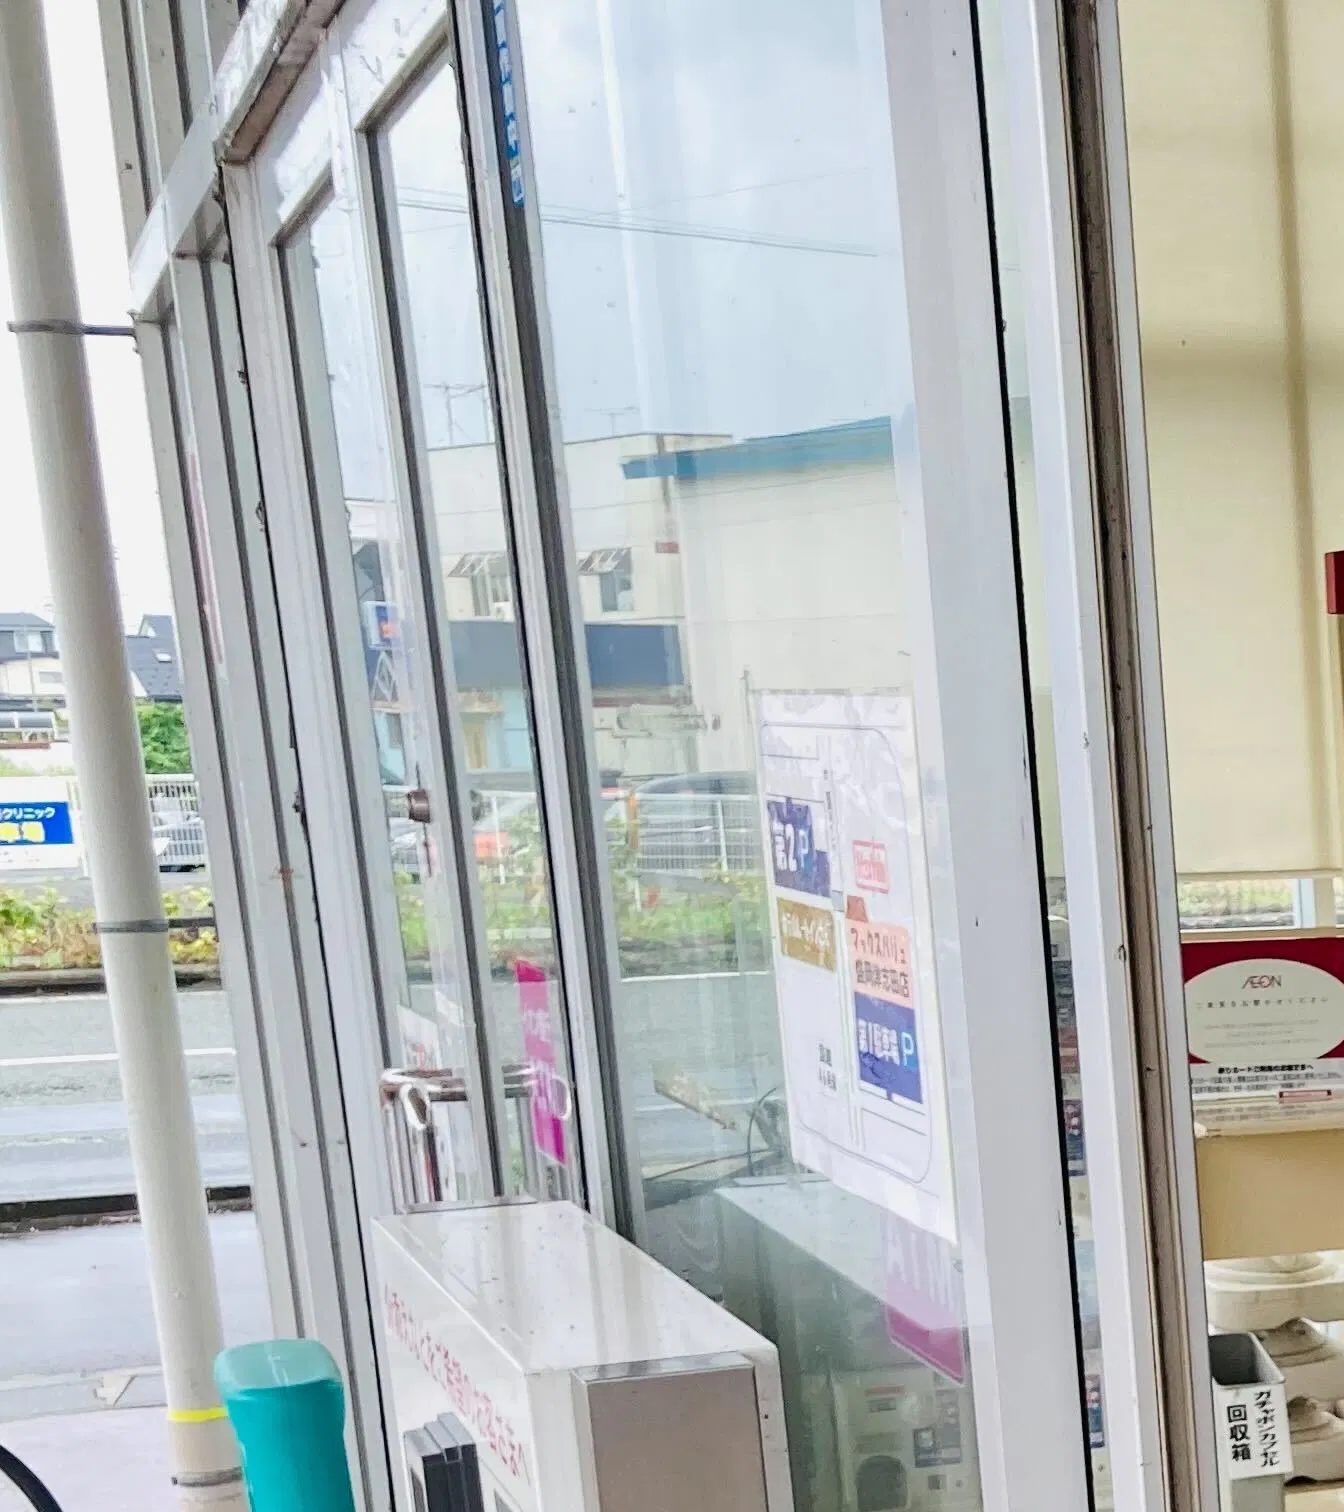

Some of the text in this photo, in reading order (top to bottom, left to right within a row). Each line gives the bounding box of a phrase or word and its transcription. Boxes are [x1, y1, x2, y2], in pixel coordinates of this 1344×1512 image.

[0, 807, 55, 820] クリニック
[1241, 975, 1282, 990] AEON
[1226, 1404, 1252, 1462] 回収箱
